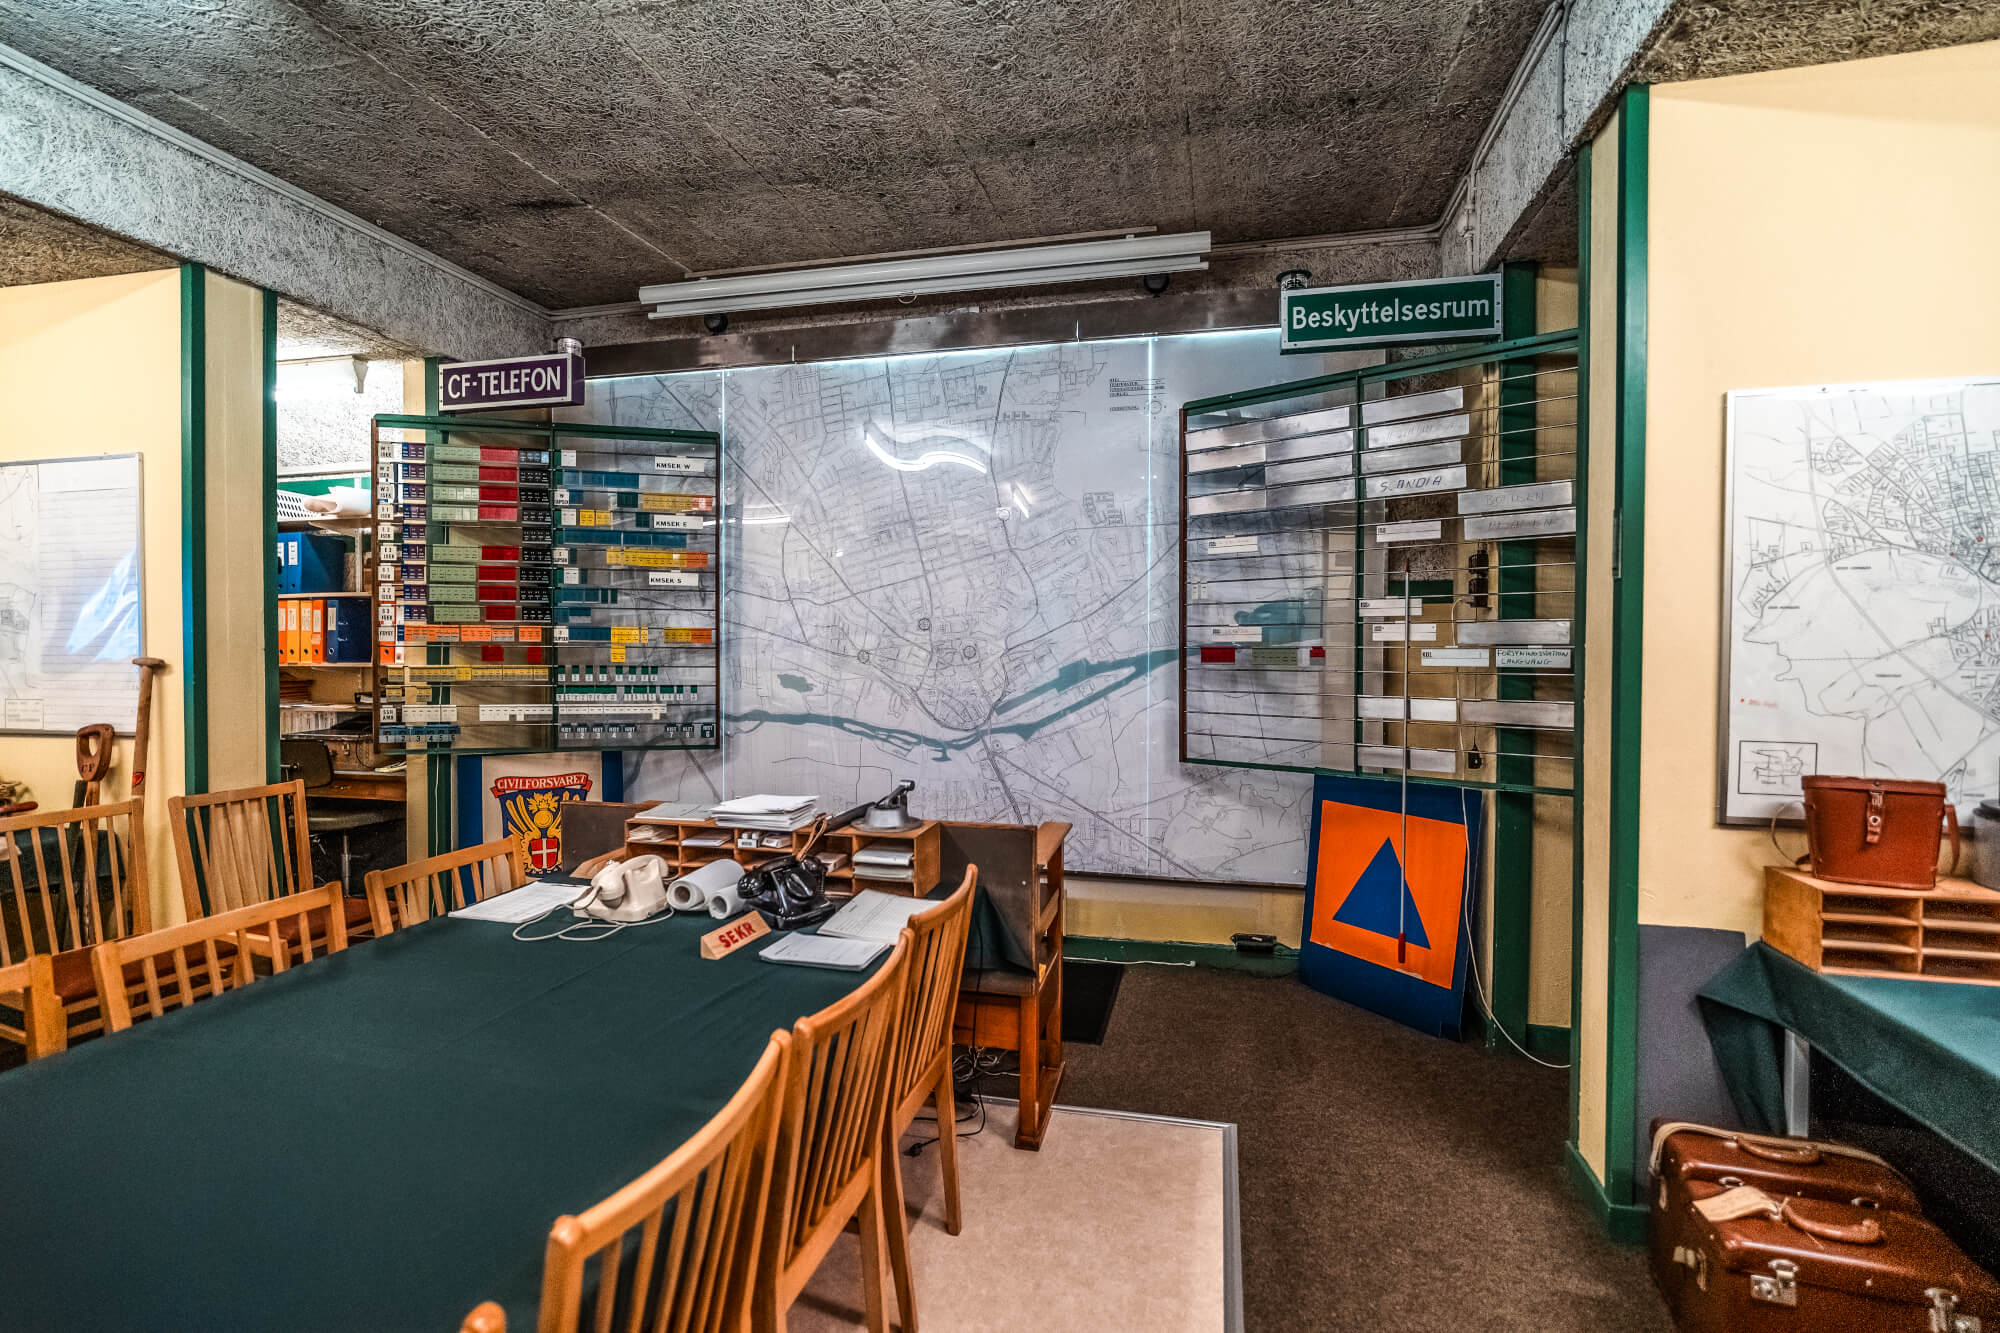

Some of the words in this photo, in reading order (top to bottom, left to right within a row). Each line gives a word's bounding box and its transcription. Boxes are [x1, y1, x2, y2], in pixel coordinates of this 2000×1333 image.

[1292, 298, 1489, 333] Beskyttelsesrum
[447, 366, 561, 399] CF-TELEFON
[497, 774, 587, 789] CIVILFORSVARET
[718, 922, 756, 948] SEKR
